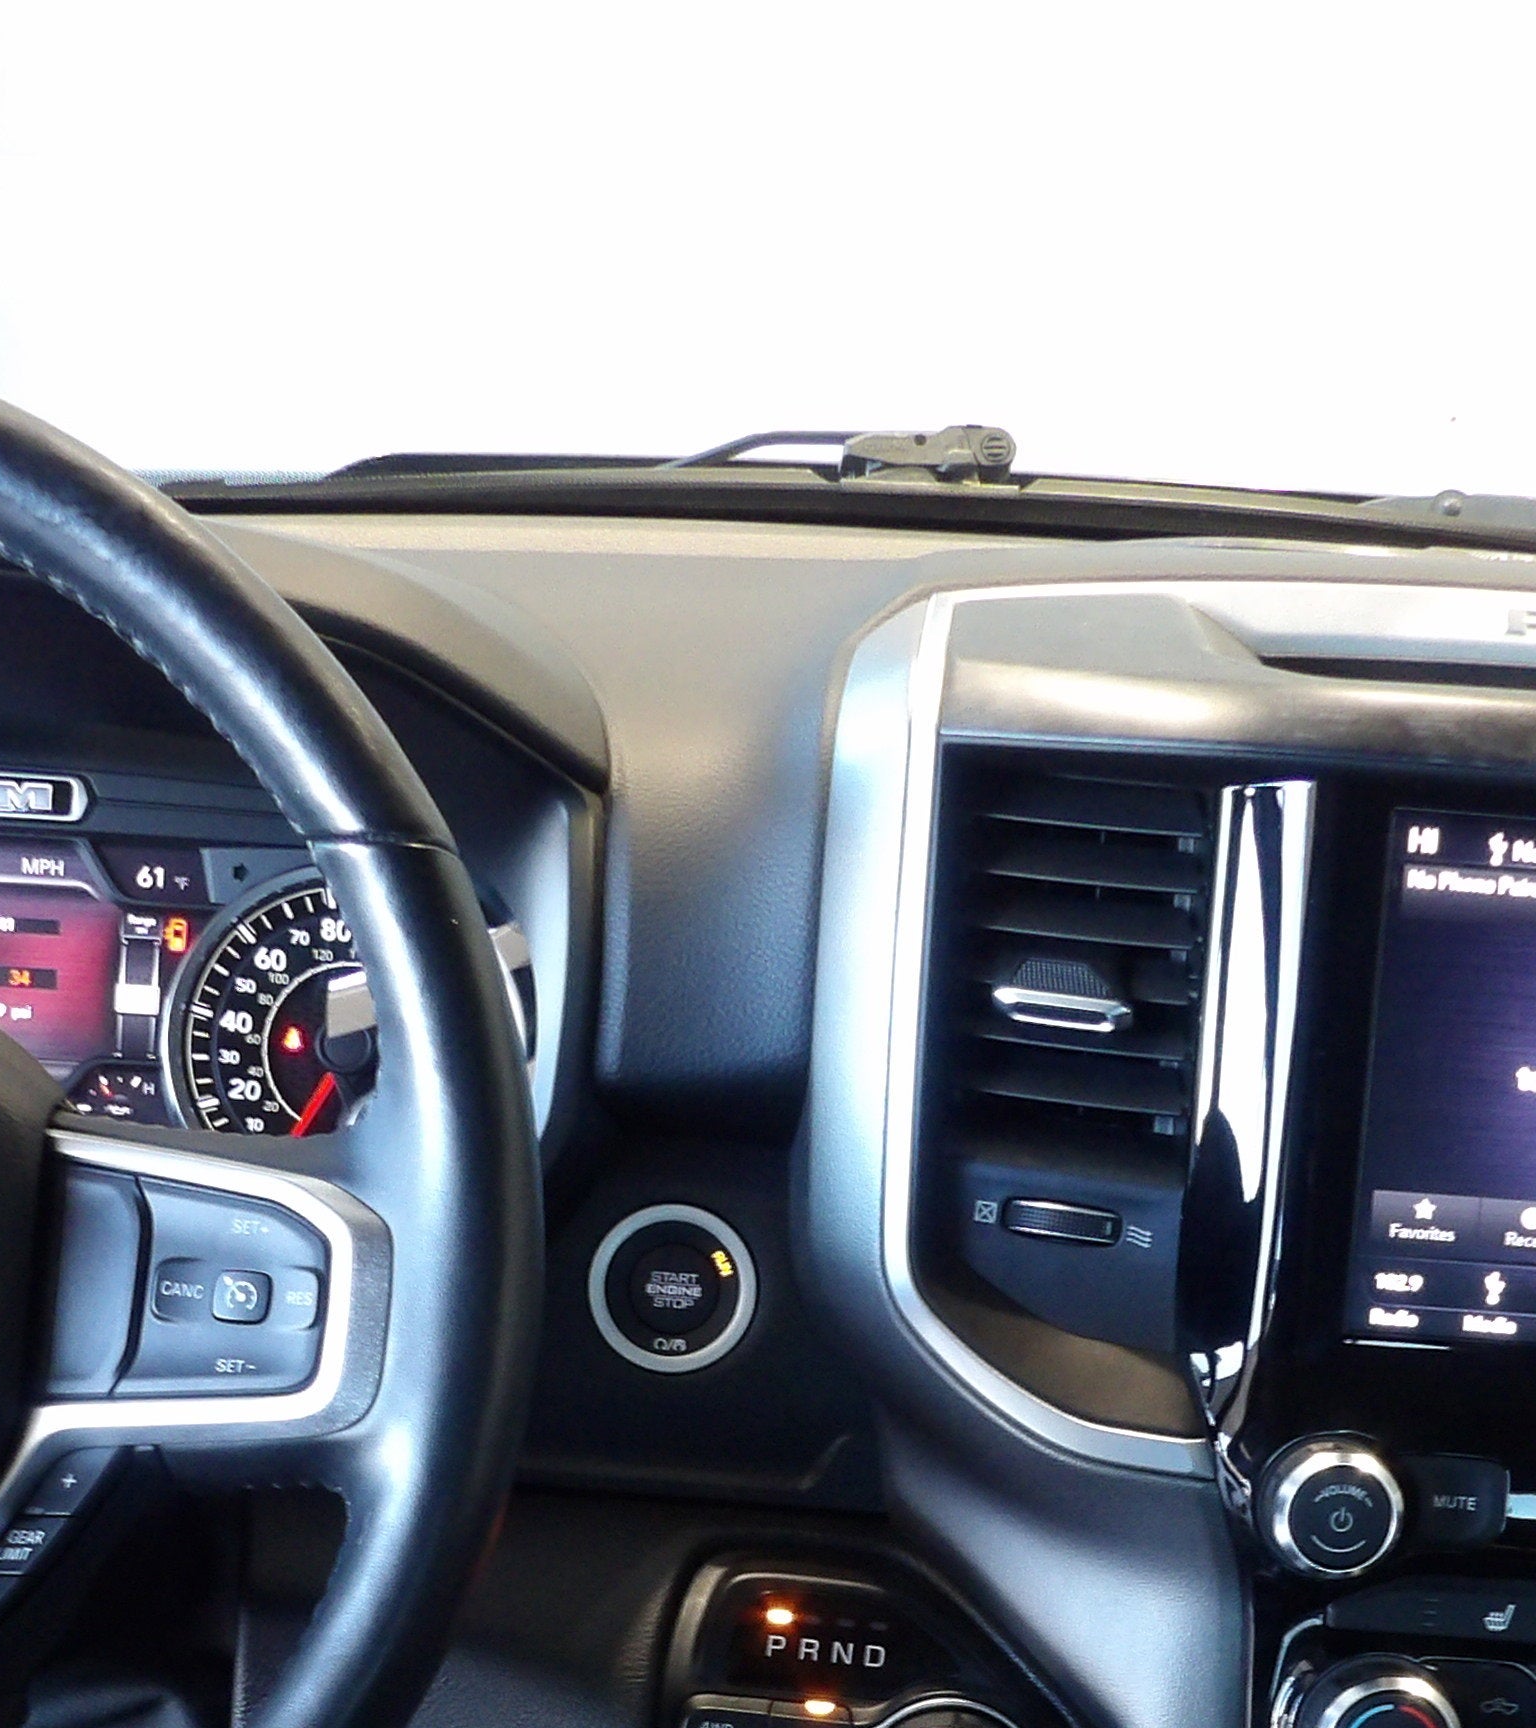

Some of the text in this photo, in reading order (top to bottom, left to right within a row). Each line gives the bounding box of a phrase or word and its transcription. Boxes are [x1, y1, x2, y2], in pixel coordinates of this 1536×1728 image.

[21, 856, 65, 877] MPH
[135, 864, 165, 889] 61
[288, 928, 311, 947] 70
[253, 947, 287, 972] 60
[313, 950, 334, 962] 120
[8, 969, 32, 987] 34
[234, 977, 257, 994] 50
[267, 971, 290, 986] 100
[219, 1010, 253, 1034] 40
[245, 1033, 262, 1045] 60
[217, 1048, 241, 1065] 30
[247, 1065, 264, 1078] 40
[227, 1077, 262, 1101] 20
[245, 1116, 265, 1134] 10
[1388, 1223, 1456, 1243] Favorites
[651, 1271, 700, 1284] START
[161, 1280, 205, 1300] CANC
[285, 1291, 313, 1306] RES
[645, 1283, 703, 1297] ENGINE
[652, 1297, 695, 1310] STOP
[1319, 1484, 1366, 1500] VOLUME
[1433, 1494, 1478, 1512] MUTE
[7, 1529, 46, 1545] GEAR
